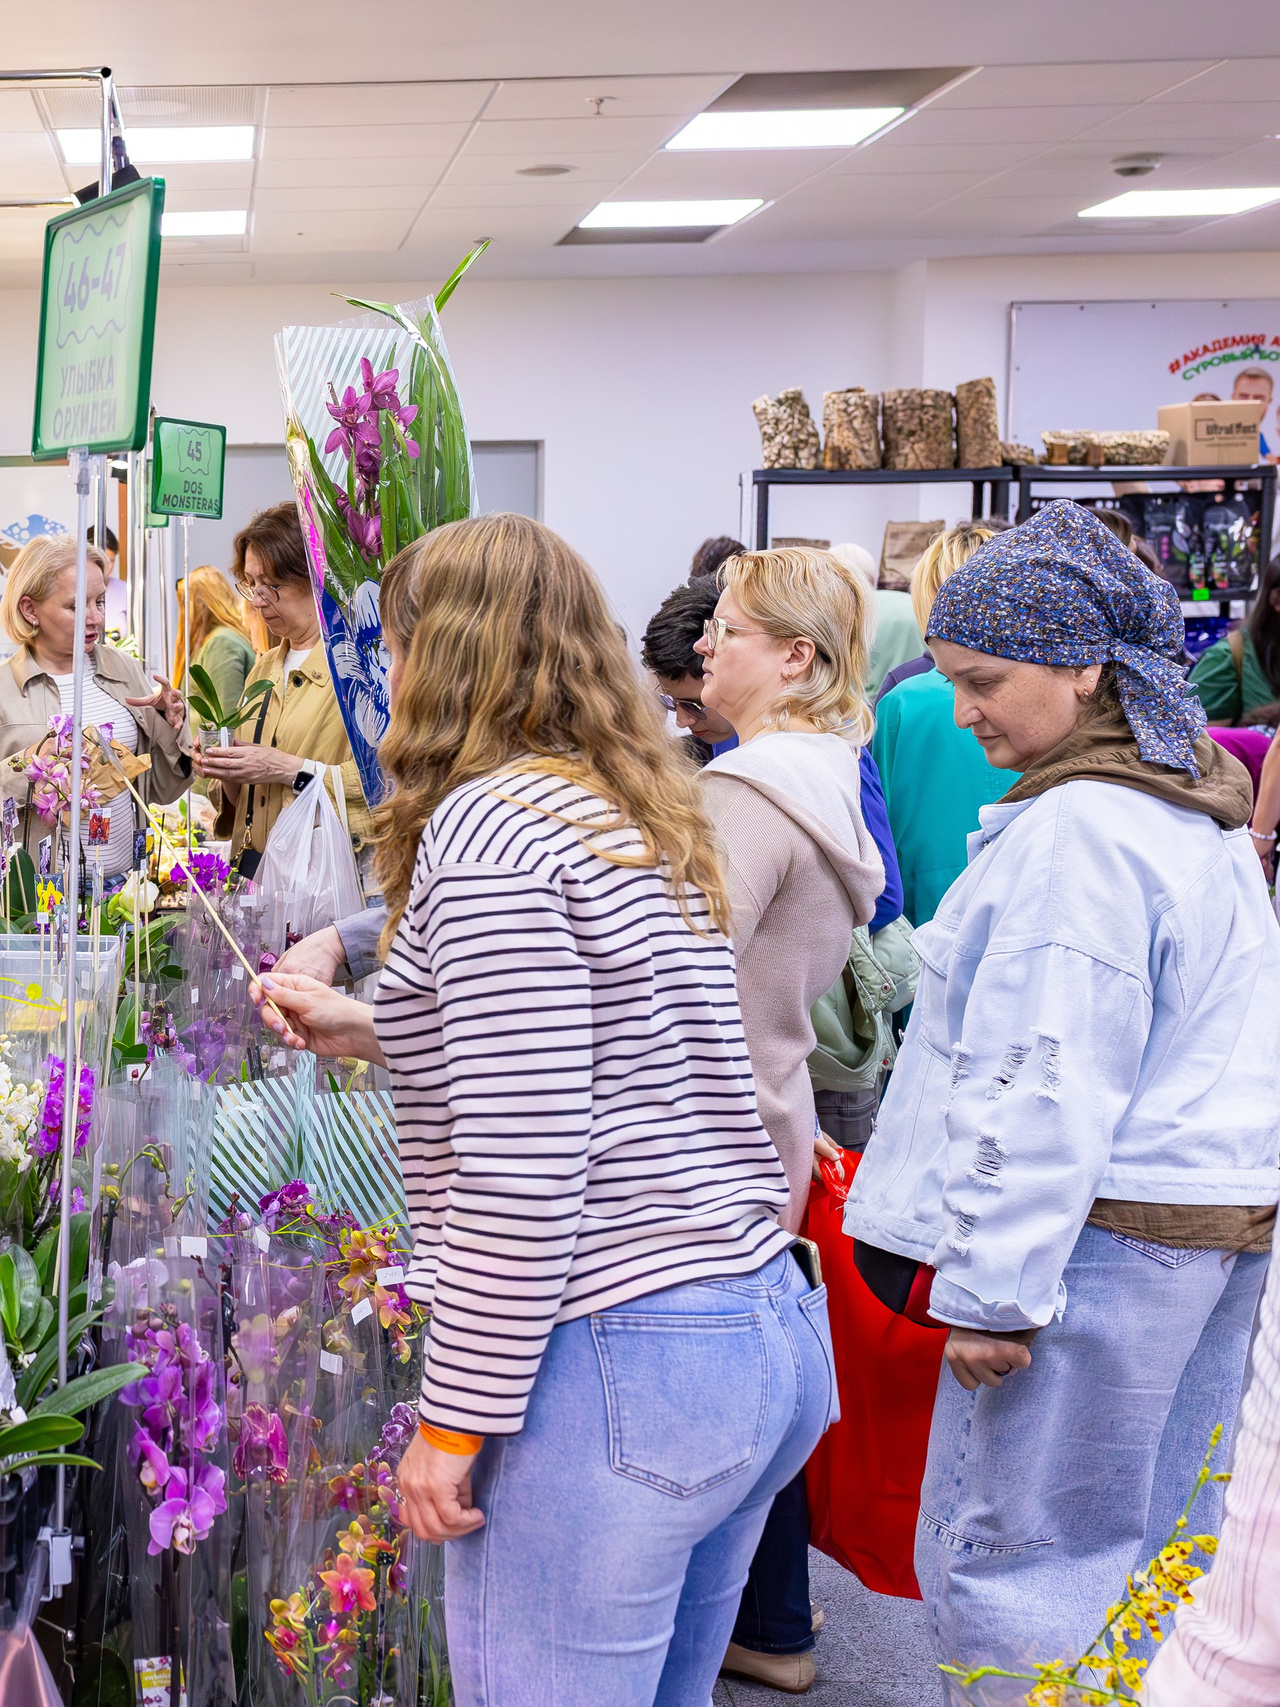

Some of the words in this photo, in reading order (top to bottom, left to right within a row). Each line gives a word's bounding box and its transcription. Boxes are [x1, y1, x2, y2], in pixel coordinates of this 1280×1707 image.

[63, 242, 127, 314] 46-47
[60, 354, 115, 400] УЛЫБКА
[187, 440, 203, 462] 45
[183, 480, 203, 495] DOS
[162, 492, 221, 513] MONSTERAS
